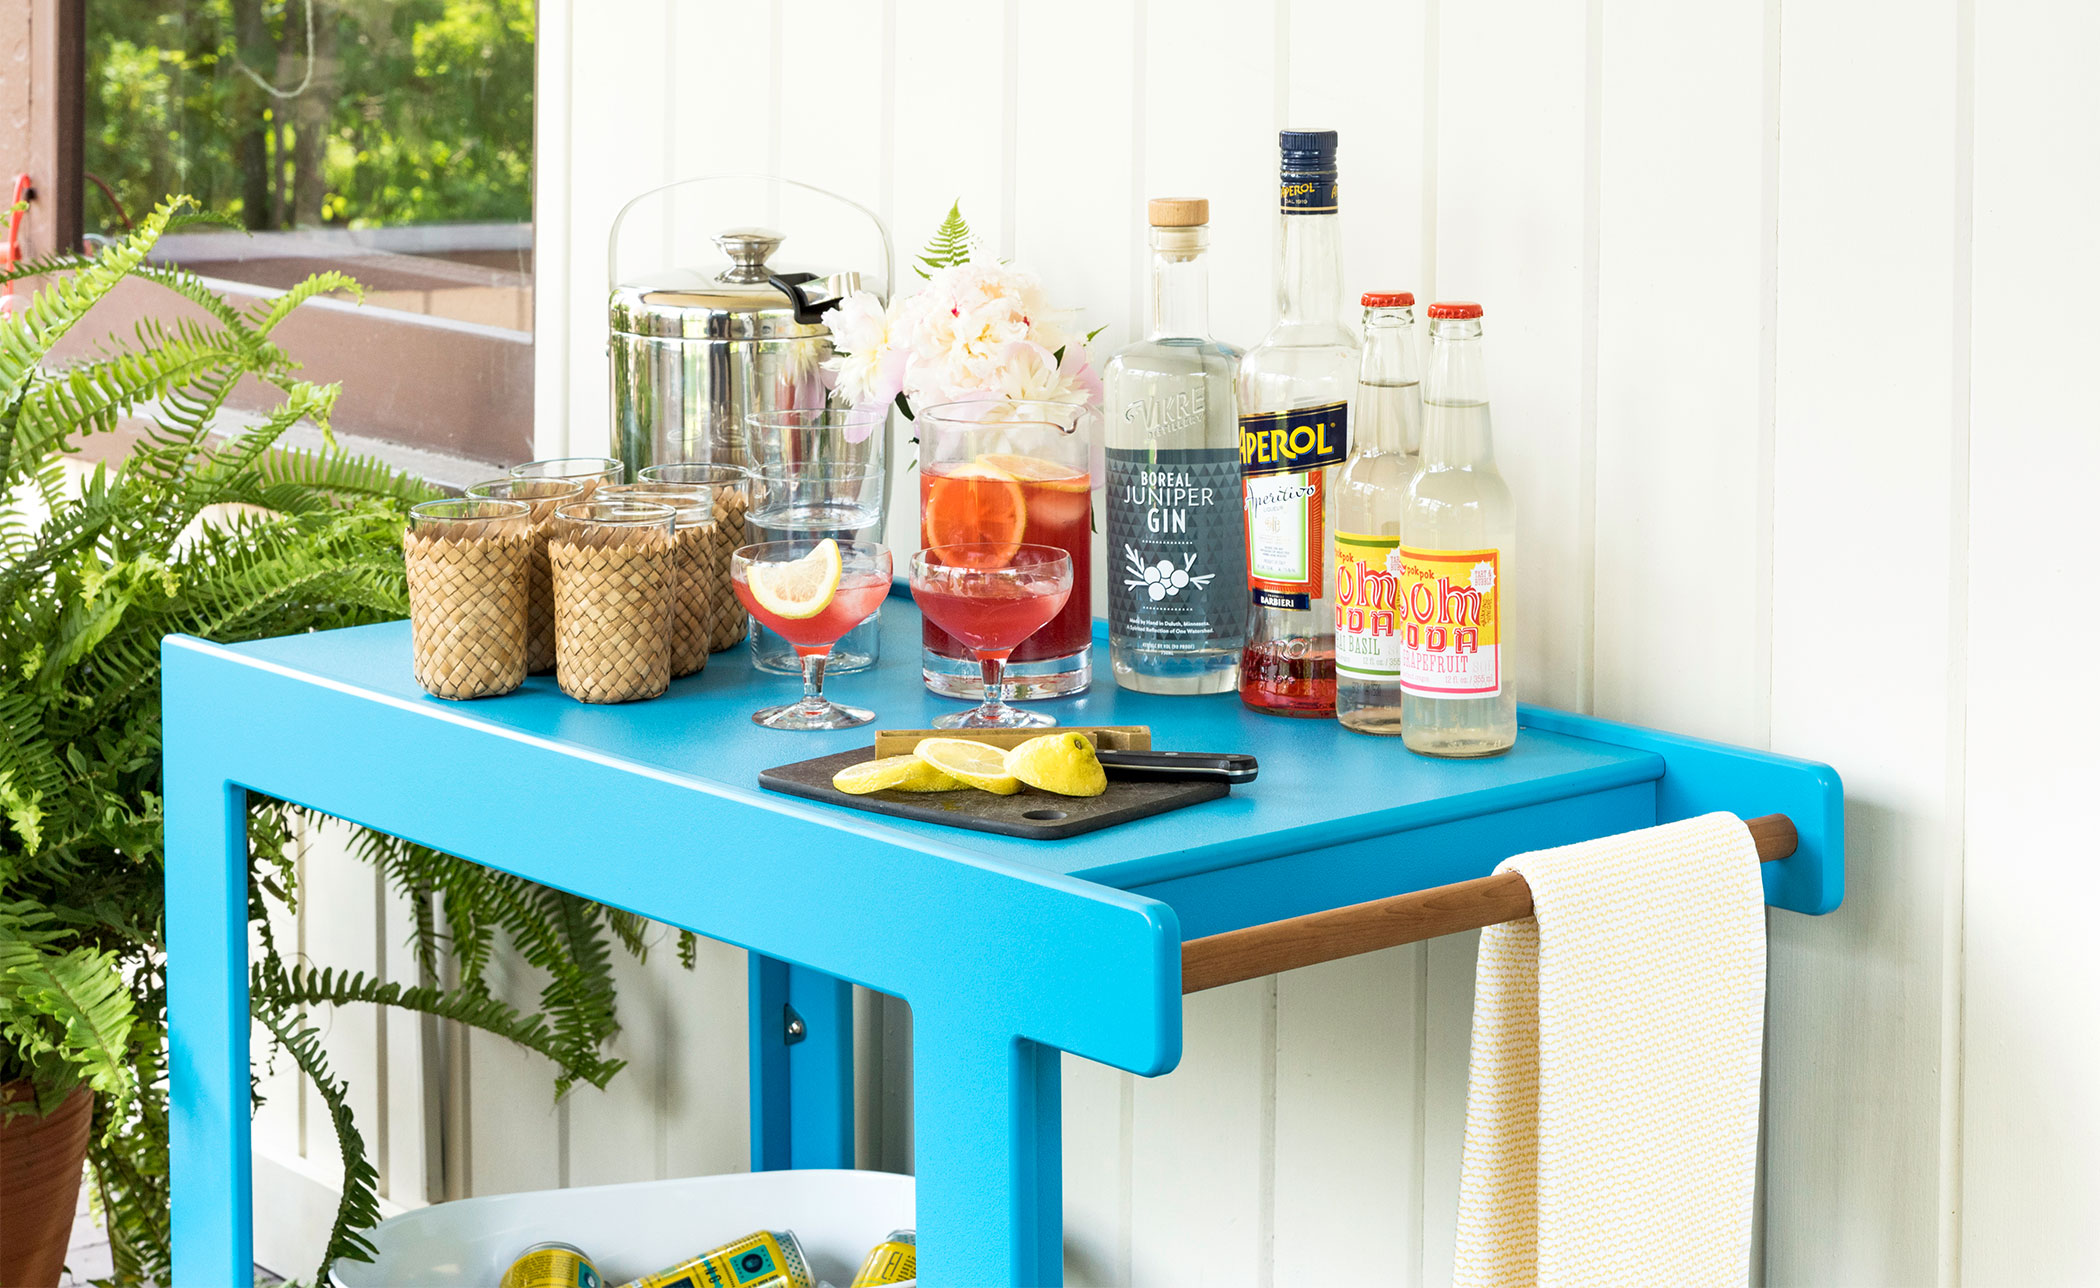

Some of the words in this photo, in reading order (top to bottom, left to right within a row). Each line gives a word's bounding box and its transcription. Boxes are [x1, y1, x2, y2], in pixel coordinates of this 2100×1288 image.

[1281, 183, 1315, 198] APEROL
[1239, 423, 1334, 466] APEROL
[1141, 471, 1192, 488] BOREAL
[1124, 485, 1214, 507] JUNIPER
[1244, 484, 1316, 518] Aperitivo
[1147, 508, 1186, 534] GIN
[1420, 569, 1435, 581] pok
[1260, 595, 1295, 608] BARBIERI
[1336, 604, 1394, 637] ODA
[1348, 635, 1380, 656] BASIL
[1400, 621, 1479, 654] ODA
